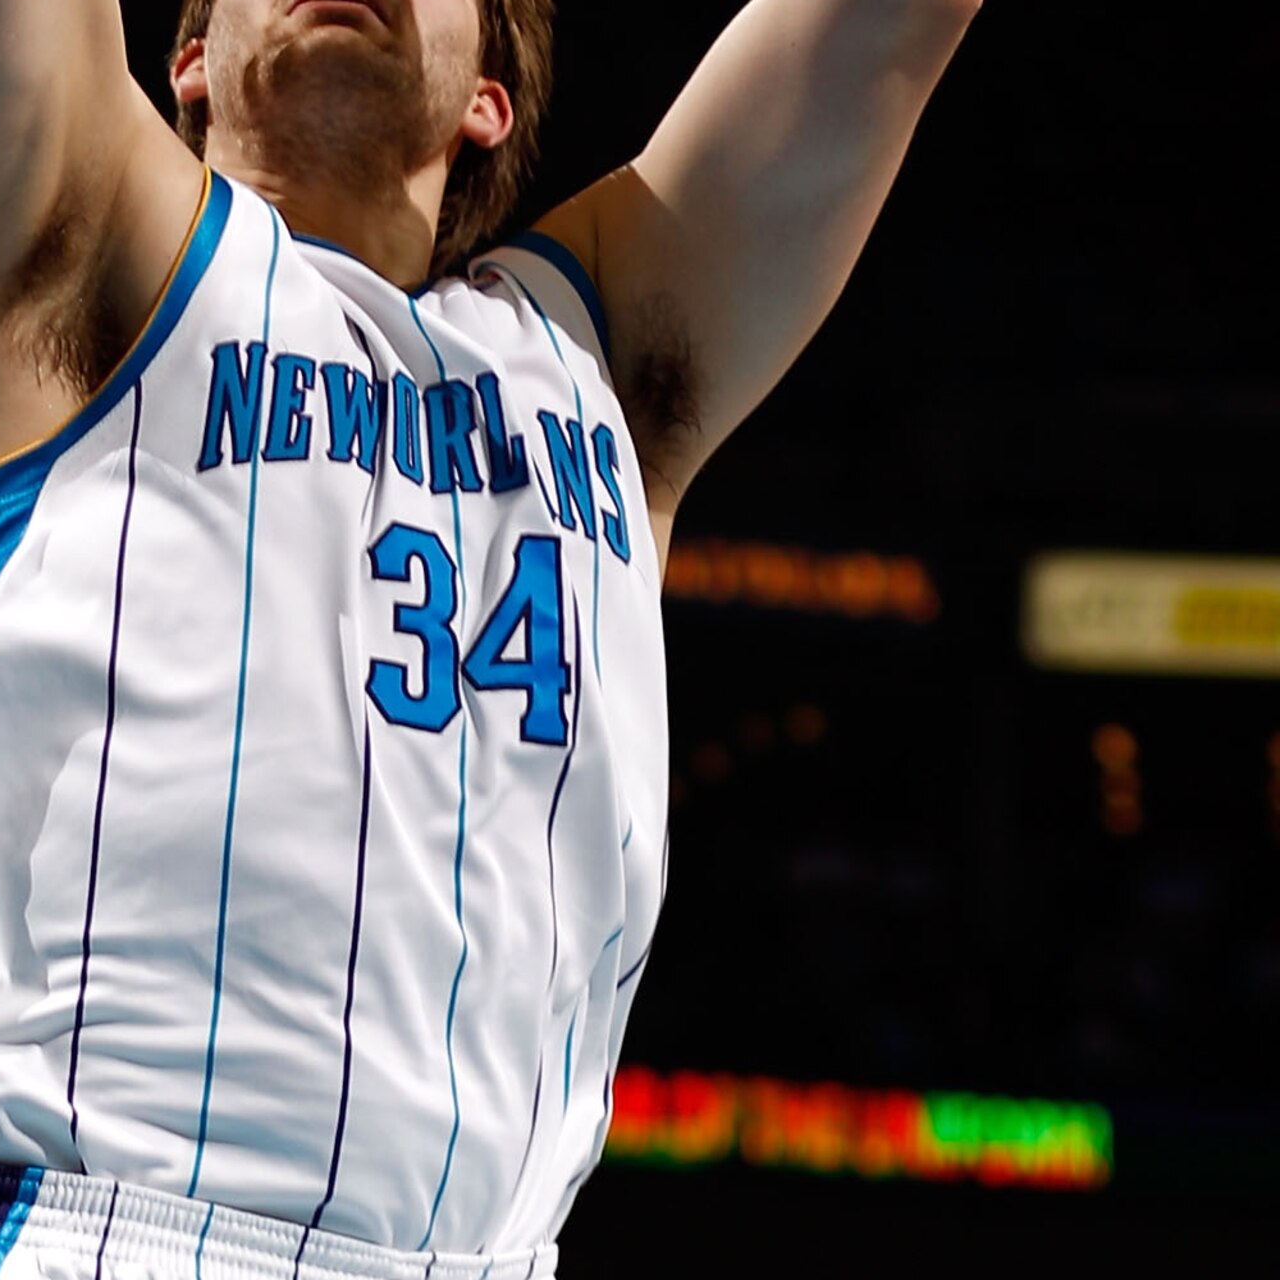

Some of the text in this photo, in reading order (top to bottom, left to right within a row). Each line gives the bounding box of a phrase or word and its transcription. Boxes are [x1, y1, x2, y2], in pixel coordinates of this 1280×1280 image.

[197, 338, 631, 565] NEW ORLNS
[365, 521, 572, 747] 34
